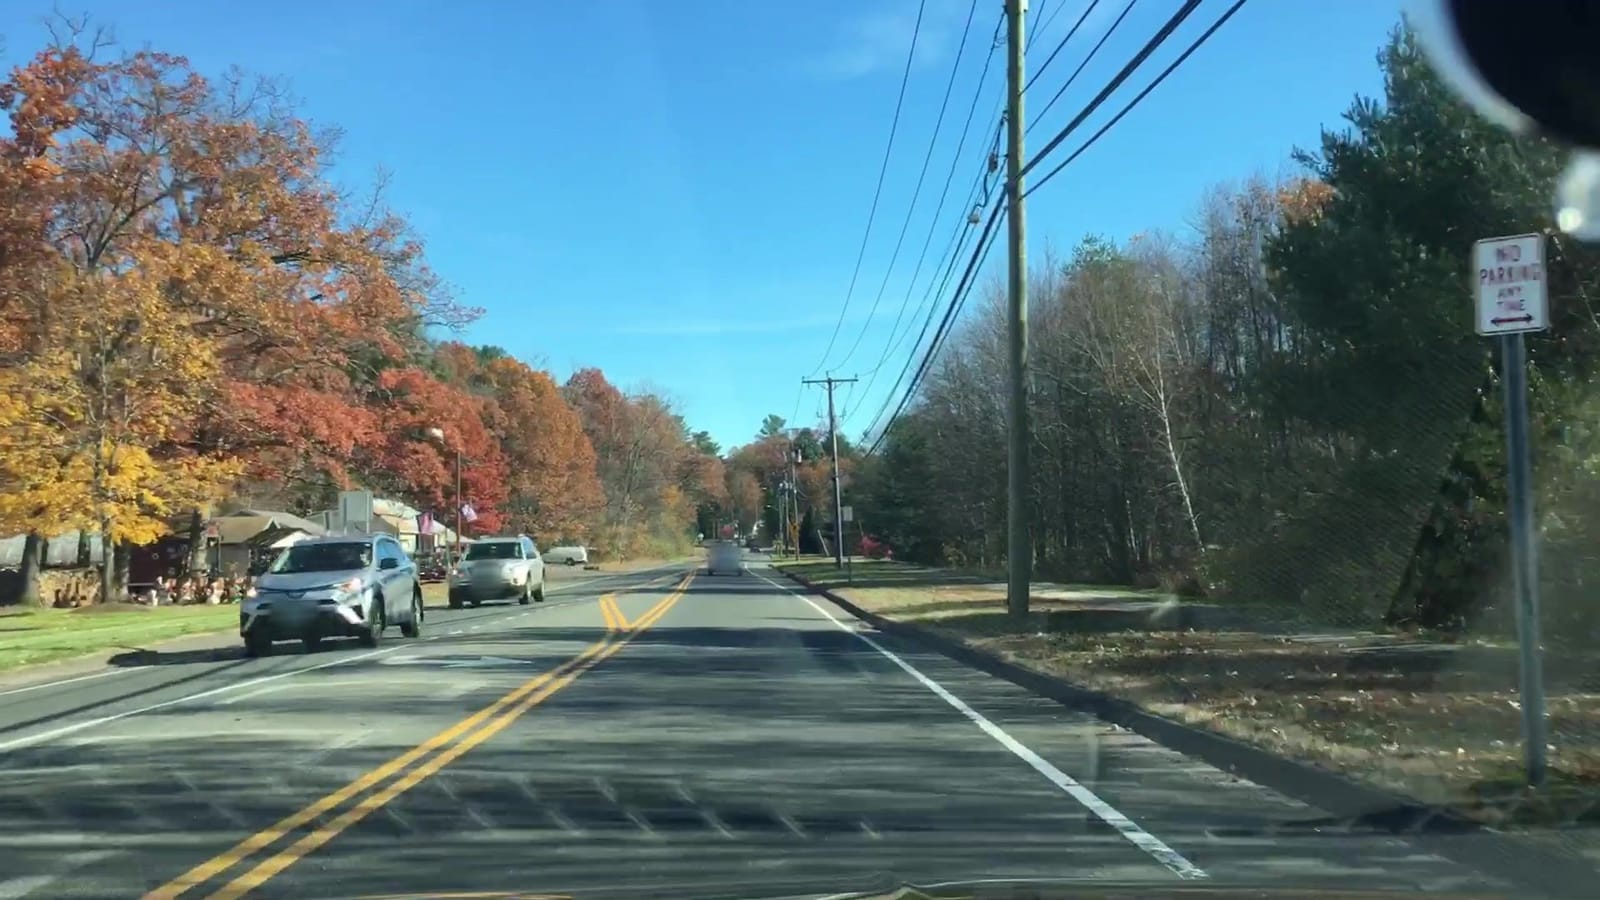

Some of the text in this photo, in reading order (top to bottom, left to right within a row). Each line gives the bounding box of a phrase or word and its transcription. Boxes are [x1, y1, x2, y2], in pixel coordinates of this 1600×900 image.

[1496, 245, 1521, 262] NO
[1480, 264, 1541, 281] PARK
[1496, 299, 1525, 311] TE
